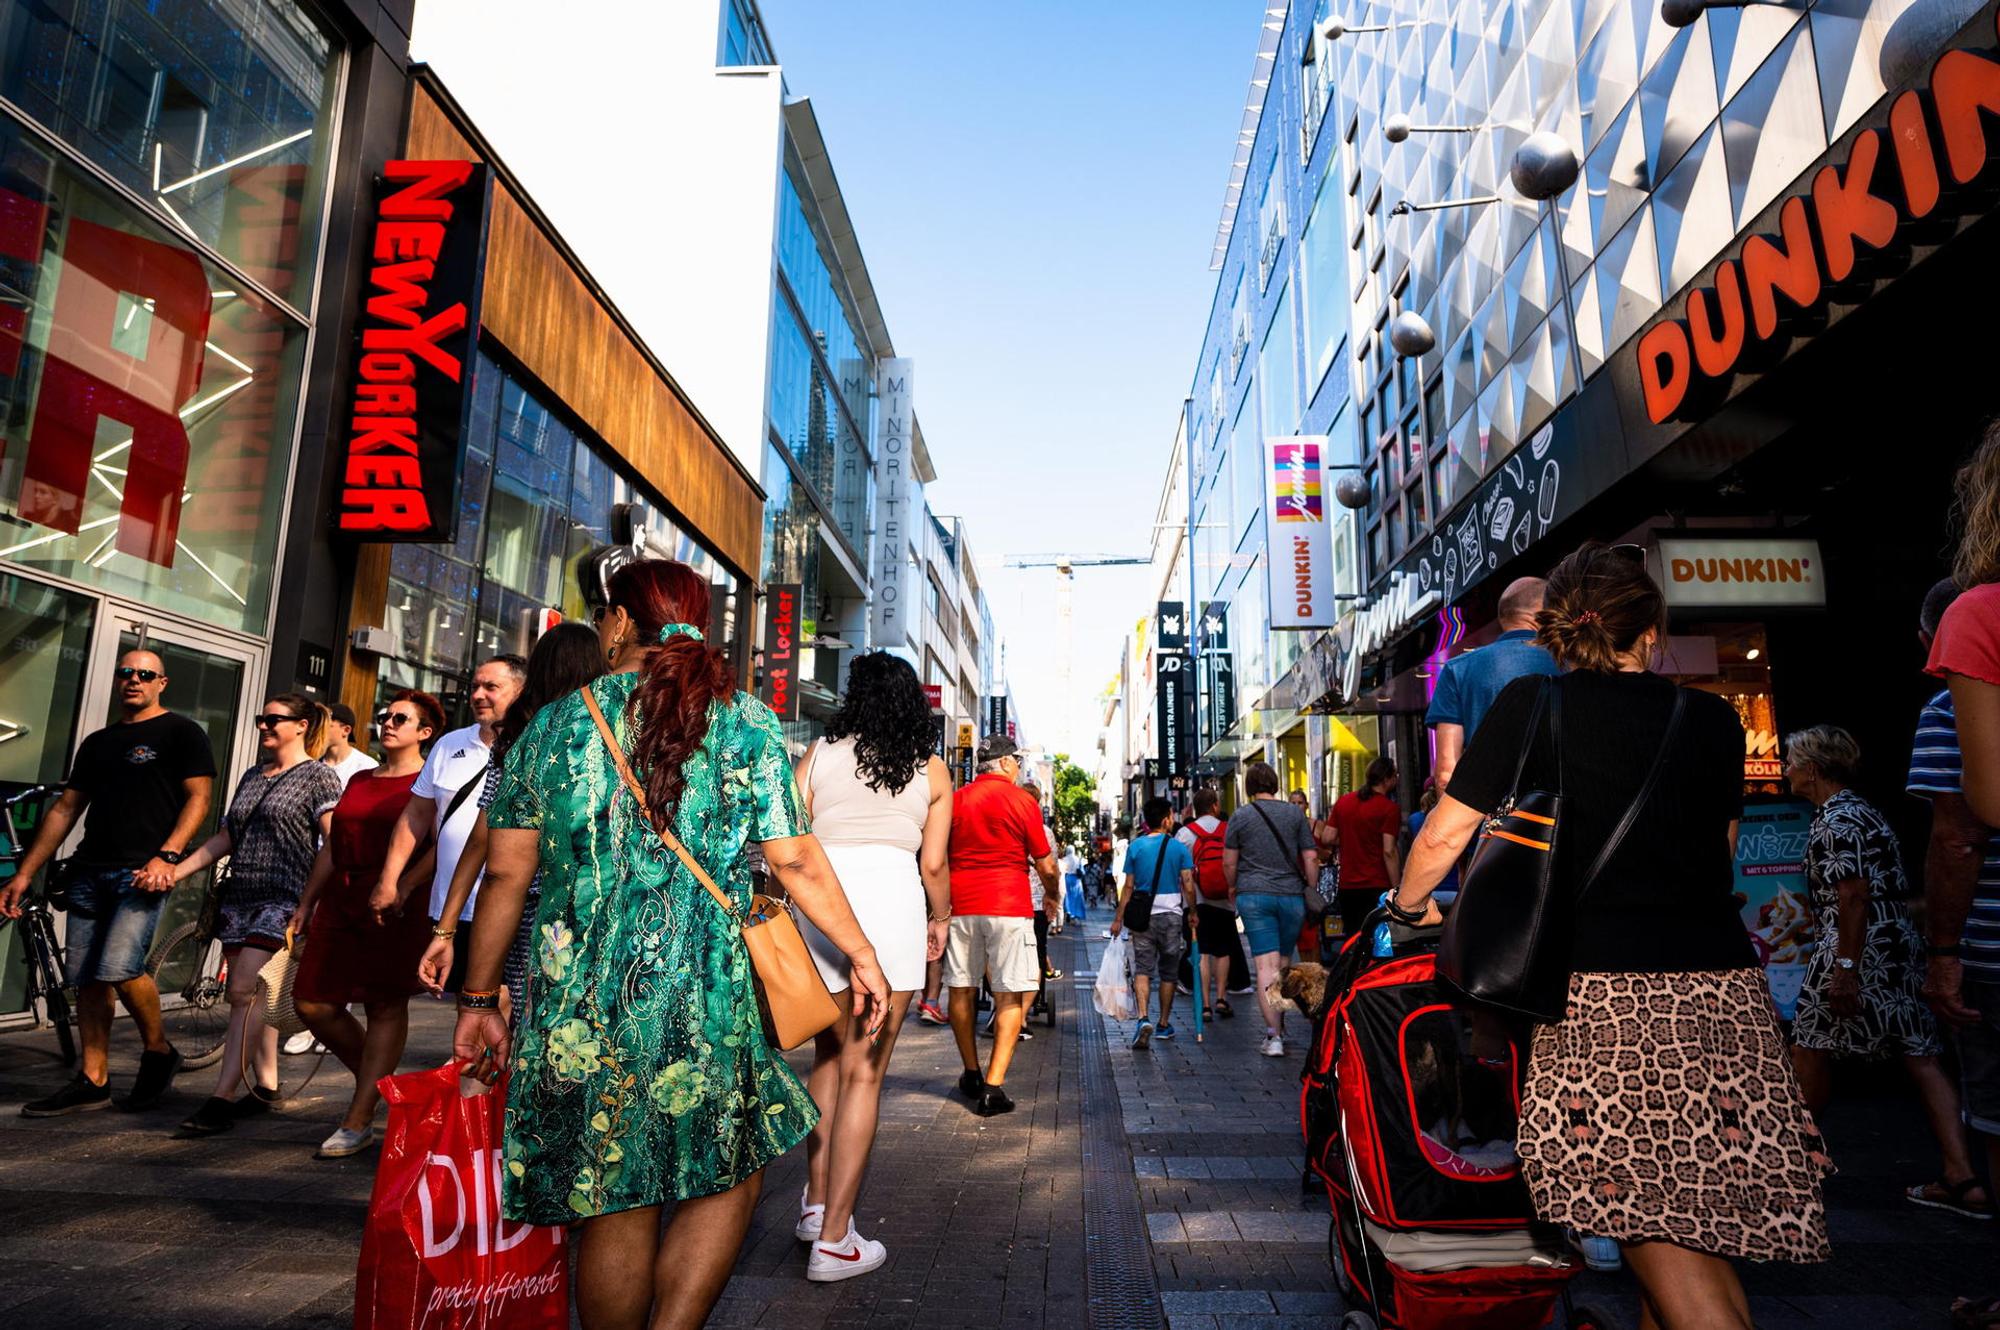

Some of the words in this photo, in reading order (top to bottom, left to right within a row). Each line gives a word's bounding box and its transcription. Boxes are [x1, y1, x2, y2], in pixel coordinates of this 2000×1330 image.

[882, 376, 905, 626] MINORITENHOF
[1294, 536, 1313, 618] DUNKIN'
[772, 591, 793, 660] Locker
[309, 655, 326, 677] 111
[1159, 657, 1181, 672] JD
[1166, 681, 1175, 726] TRAINERS
[1167, 735, 1177, 760] KING
[1744, 762, 1782, 776] KÖLN
[1769, 864, 1804, 874] TOPPING
[417, 1148, 562, 1259] DID
